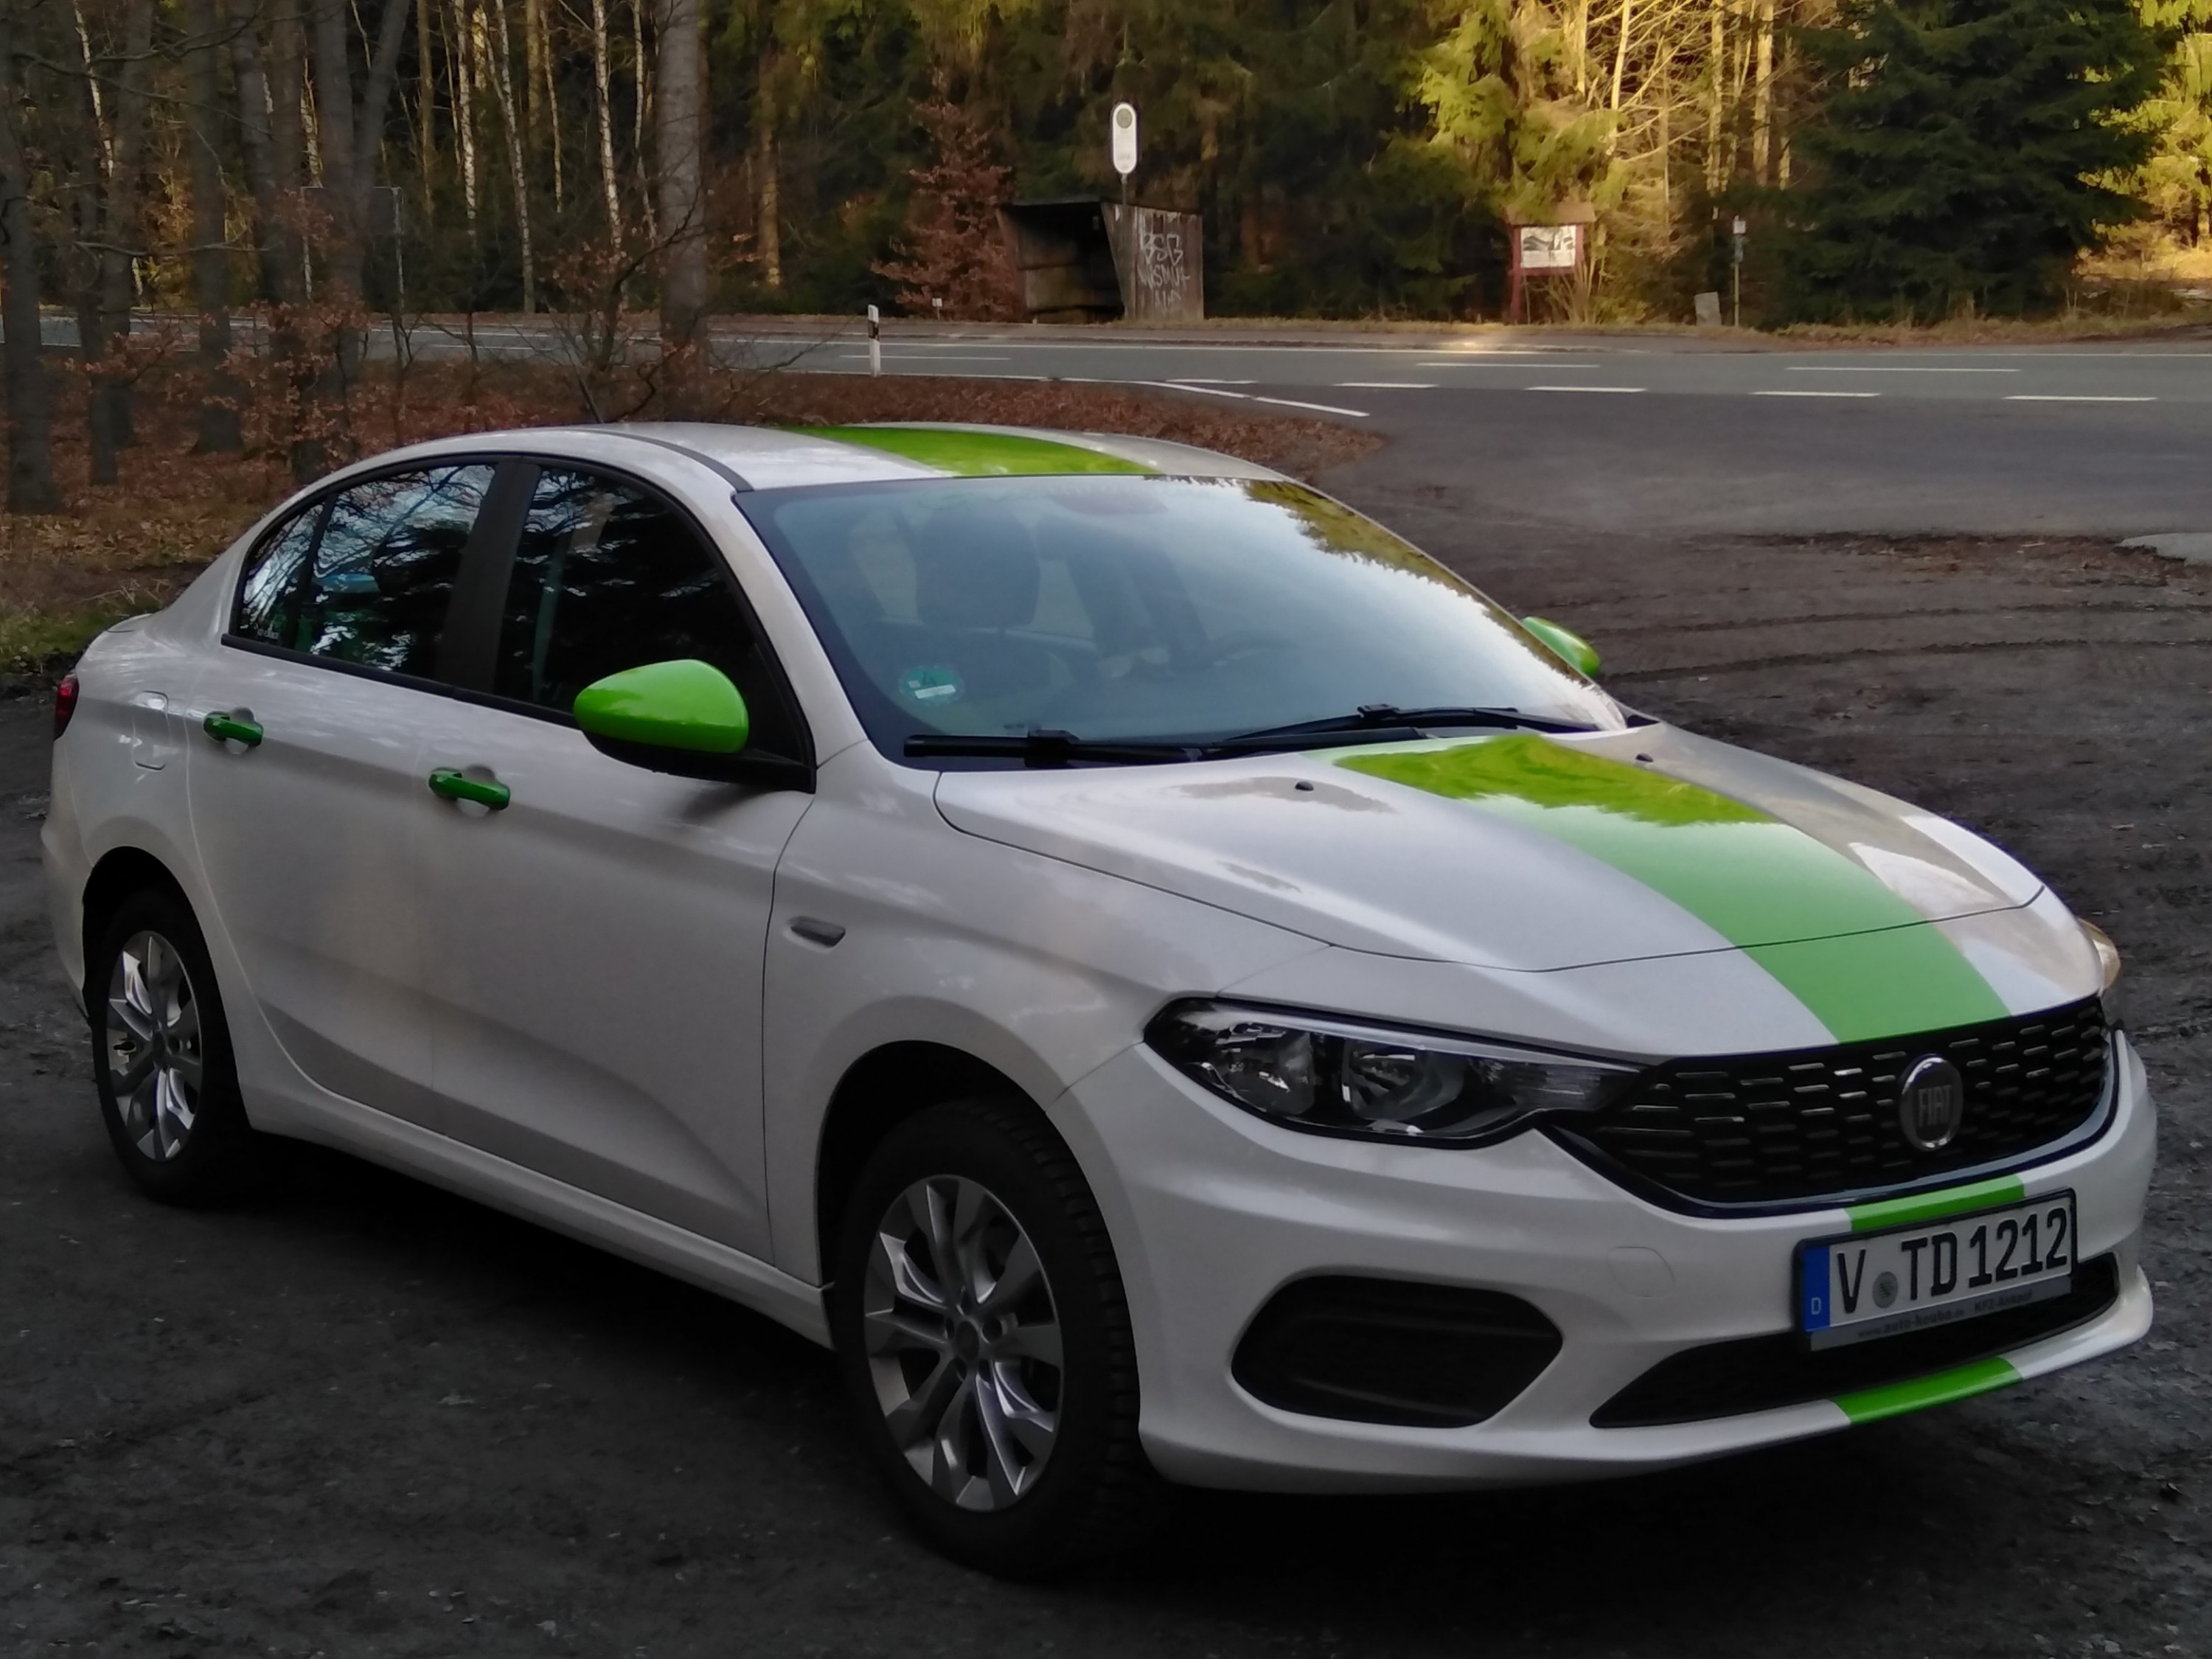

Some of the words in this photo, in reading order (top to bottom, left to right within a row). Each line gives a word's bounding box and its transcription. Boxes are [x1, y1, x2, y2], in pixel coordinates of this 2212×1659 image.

[1138, 232, 1184, 265] BSG
[1918, 1084, 1952, 1127] FIAT
[1837, 1249, 1866, 1313] V
[1811, 1297, 1822, 1315] D
